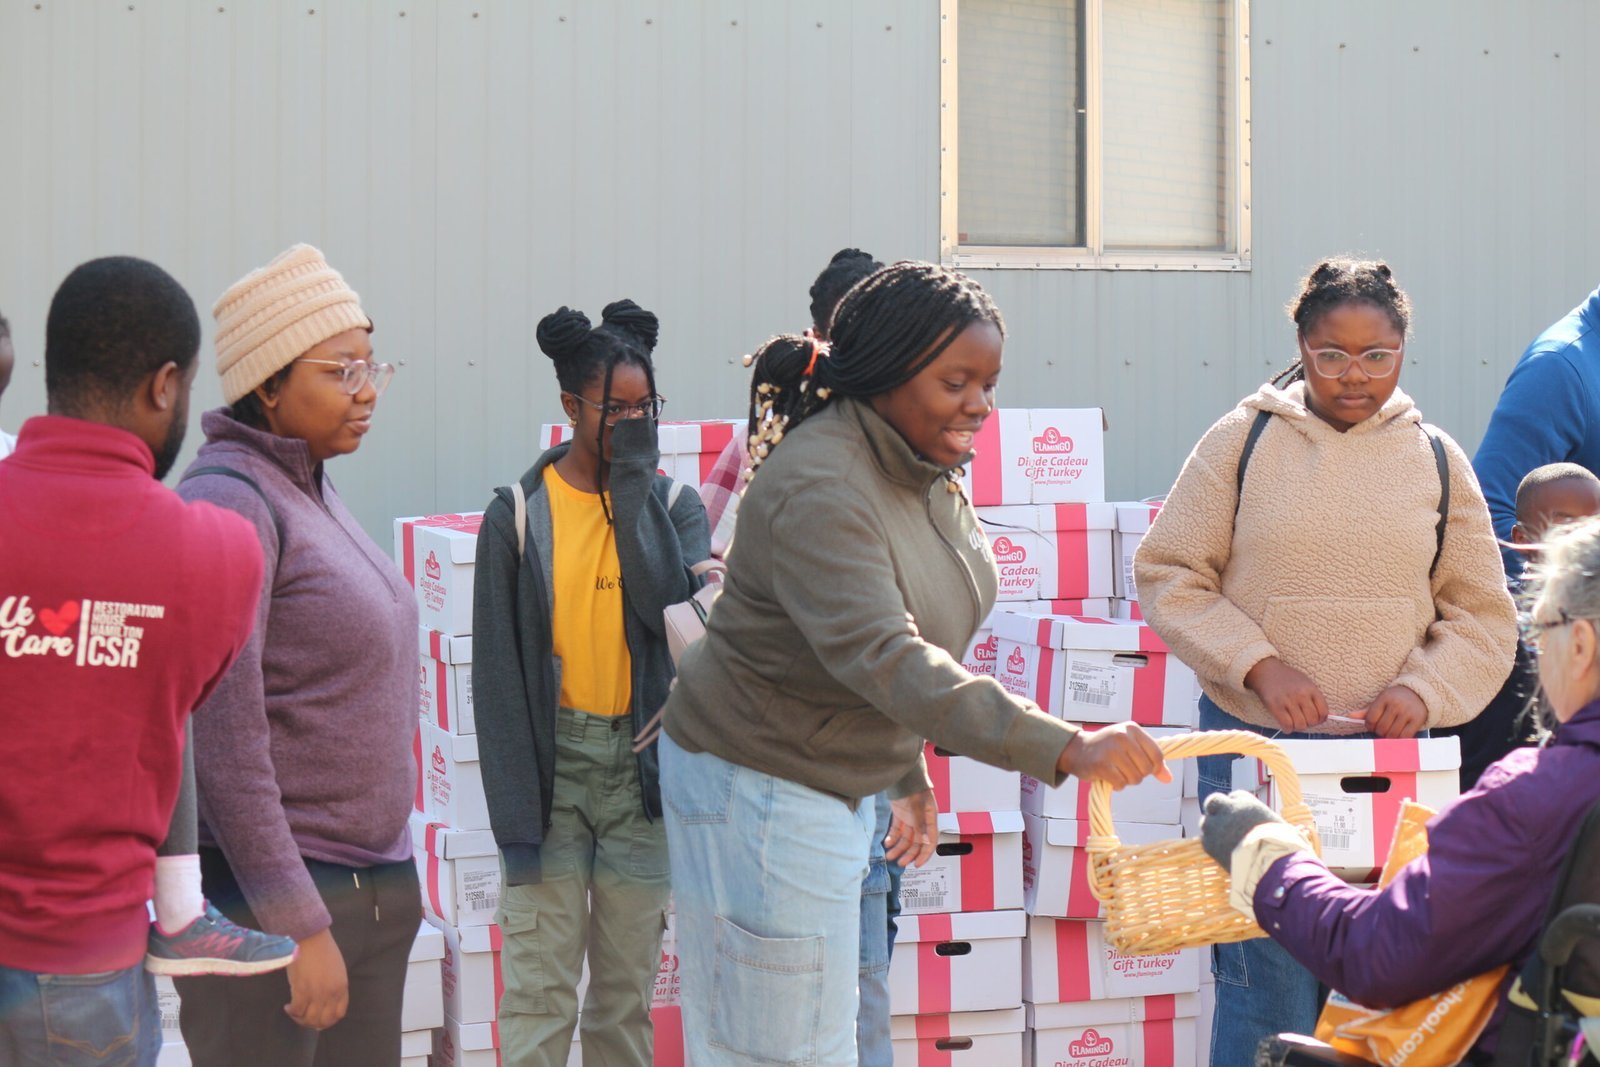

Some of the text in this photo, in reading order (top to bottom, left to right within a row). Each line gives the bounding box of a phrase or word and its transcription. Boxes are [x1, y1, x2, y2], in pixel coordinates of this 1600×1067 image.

[1034, 441, 1071, 452] FLAMINGO
[1050, 456, 1088, 467] Cadeau
[1047, 466, 1082, 480] Turkey
[596, 575, 615, 590] We
[999, 576, 1035, 589] Turkey
[92, 600, 165, 619] RESTORATION
[91, 613, 127, 626] HOUSE
[90, 624, 144, 640] HAMILTON
[0, 626, 74, 658] Care
[87, 635, 140, 668] CSR
[1113, 957, 1175, 973] Gift Turkey
[1388, 979, 1473, 1067] chool.com
[1072, 1042, 1111, 1056] FLAMINGO
[1089, 1057, 1129, 1067] Cadeau
